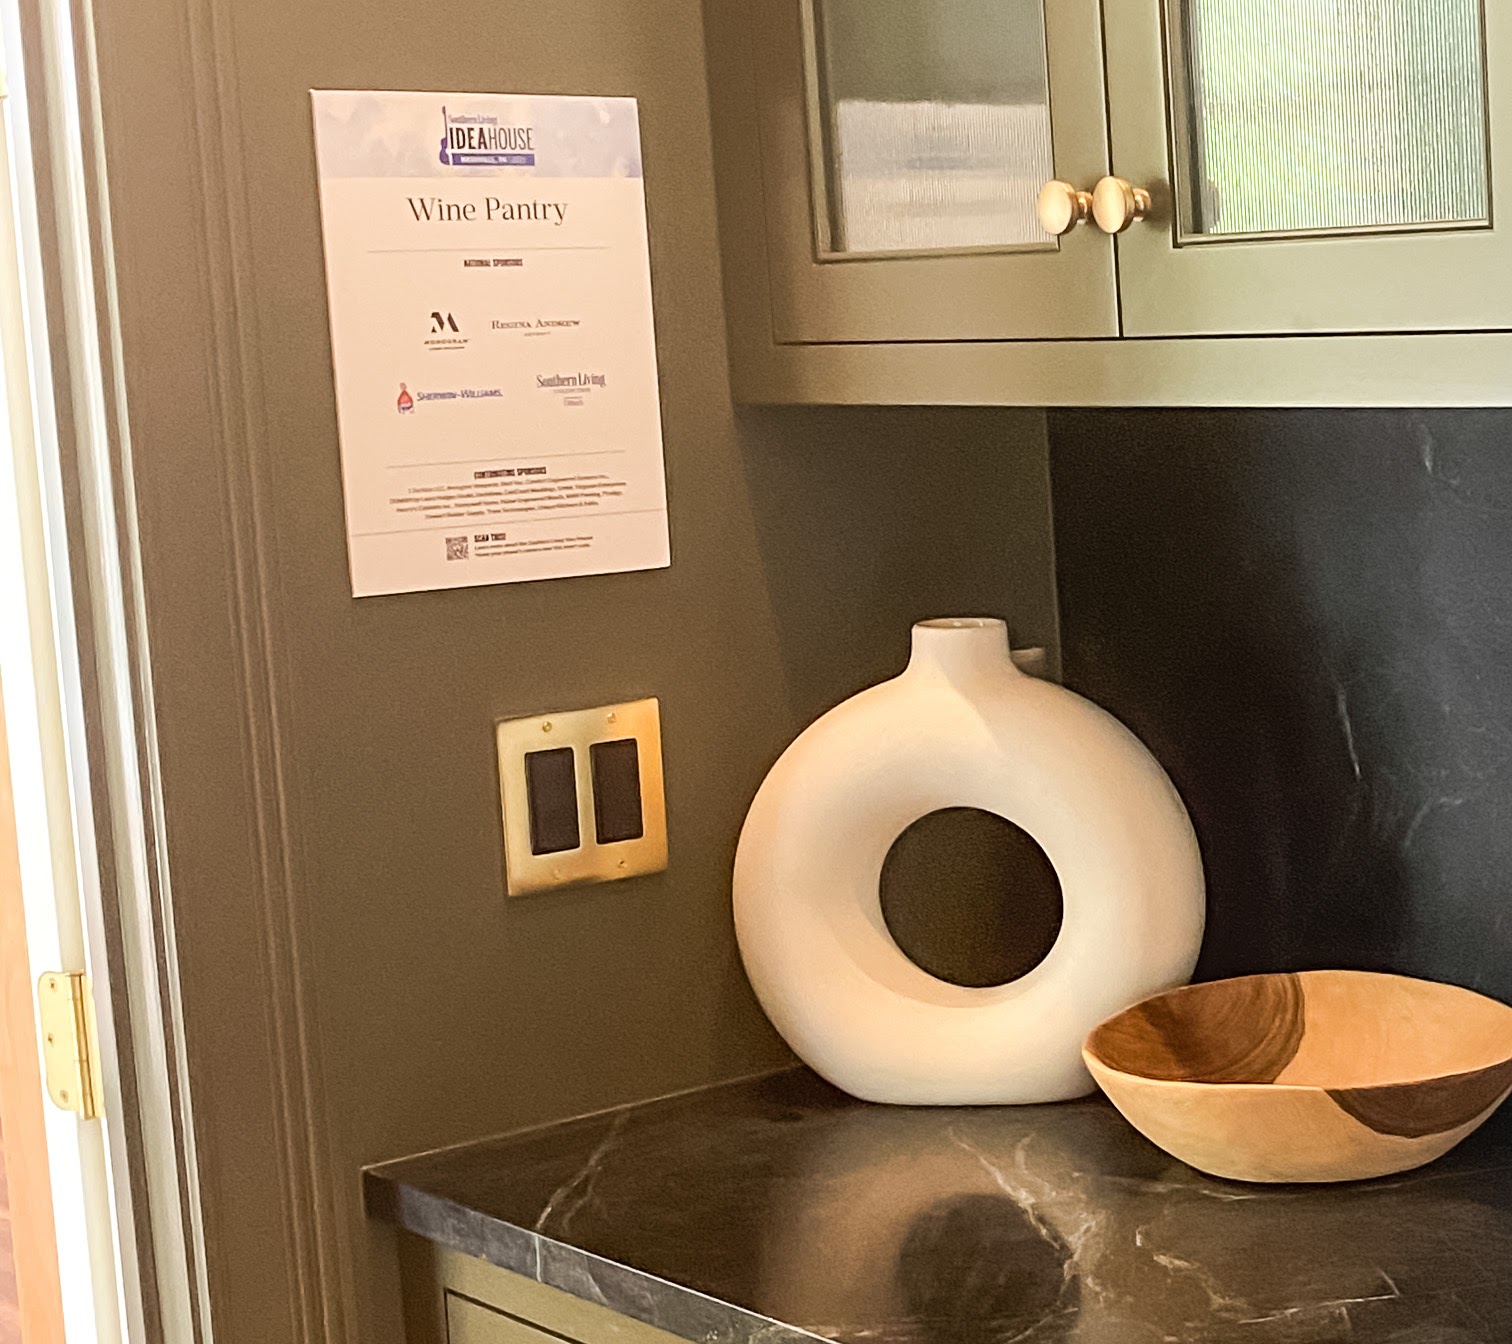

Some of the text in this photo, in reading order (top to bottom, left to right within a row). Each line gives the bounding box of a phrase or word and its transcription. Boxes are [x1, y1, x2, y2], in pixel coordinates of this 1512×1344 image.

[407, 196, 568, 227] Wine Pantry
[536, 372, 607, 389] Southern Living
